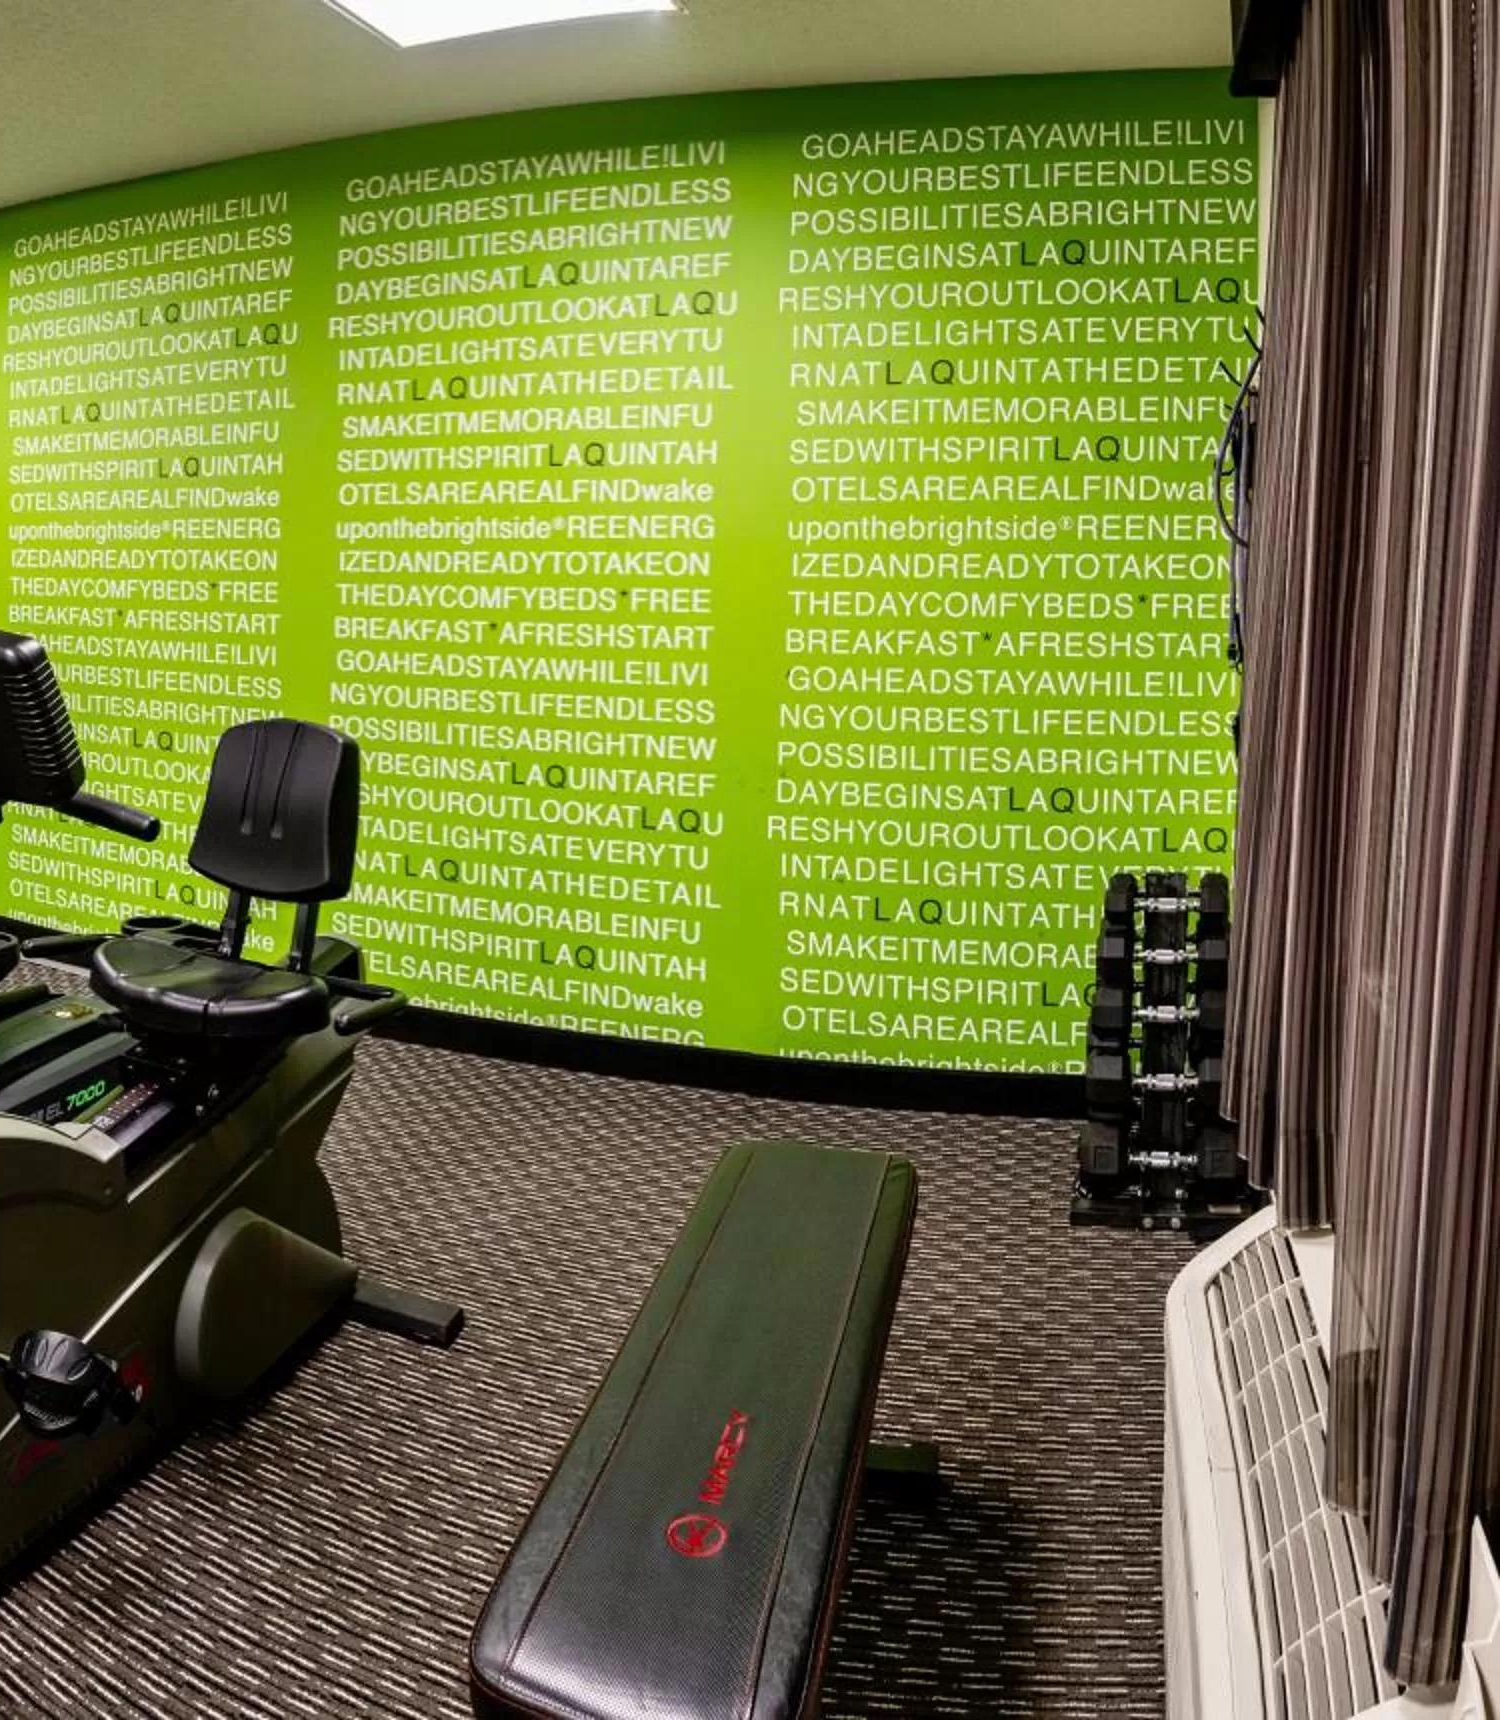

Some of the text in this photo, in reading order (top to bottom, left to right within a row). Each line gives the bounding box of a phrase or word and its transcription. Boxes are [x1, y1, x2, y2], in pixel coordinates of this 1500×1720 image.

[802, 119, 1245, 160] GOAHEADSTAYAWHILE!LIVI
[346, 140, 725, 203] GOAHEADSTAYAWHILE!LIVI
[792, 157, 1252, 198] NGYOURBESTLIFEENDLESS
[14, 191, 288, 258] GOAHEADSTAYAWHILE!LIVI
[339, 177, 731, 236] NGYOURBESTLIFEENDLESS
[791, 198, 1256, 236] POSSIBILITIESABRIGHTNEW
[9, 223, 292, 288] NGYOURBESTLIFEENDLESS
[337, 215, 732, 272] POSSIBILITIESABRIGHTNEW
[788, 238, 1256, 275] DAYBEGINSATLAQUINTAREF
[8, 256, 293, 316] POSSIBILITIESABRIGHTNEW
[336, 252, 731, 305] DAYBEGINSATLAQUINTAREF
[7, 289, 292, 344] DAYBEGINSATLAQUINTAREF
[328, 290, 738, 339] RESHYOUROUTLOOKATLAQU
[3, 323, 298, 373] RESHYOUROUTLOOKATLAQU
[339, 327, 722, 370] INTADELIGHTSATEVERYTU
[10, 356, 286, 400] INTADELIGHTSATEVERYTU
[337, 365, 734, 405] RNATLAQUINTATHEDETAIL
[8, 388, 295, 428] RNATLAQUINTATHEDETAIL
[342, 405, 712, 439] SMAKEITMEMORABLEINFU
[12, 422, 279, 456] SMAKEITMEMORABLEINFU
[337, 440, 718, 473] SEDWITHSPIRITLAQUINTAH
[9, 452, 283, 484] SEDWITHSPIRITLAQUINTAH
[11, 488, 280, 511] OTELSAREAREALFINDwake
[338, 479, 715, 506] OTELSAREAREALFINDwake
[12, 550, 278, 572] IZEDANDREADYTOTAKEON
[339, 551, 710, 577] IZEDANDREADYTOTAKEON
[337, 650, 708, 687] GOAHEADSTAYAWHILE!LIVI
[787, 665, 1237, 699] GOAHEADSTAYAWHILE!LIVI
[330, 681, 715, 724] NGYOURBESTLIFEENDLESS
[328, 715, 717, 761] POSSIBILITIESABRIGHTNEW
[360, 752, 716, 799] YBEGINSATLAQUINTAREF
[359, 784, 723, 837] SHYOUROUTLOOKATLAQU
[354, 850, 721, 910] NATLAQUINTATHEDETAIL
[331, 912, 707, 982] SEDWITHSPIRITLAQUINTAH
[67, 1079, 106, 1111] 7000
